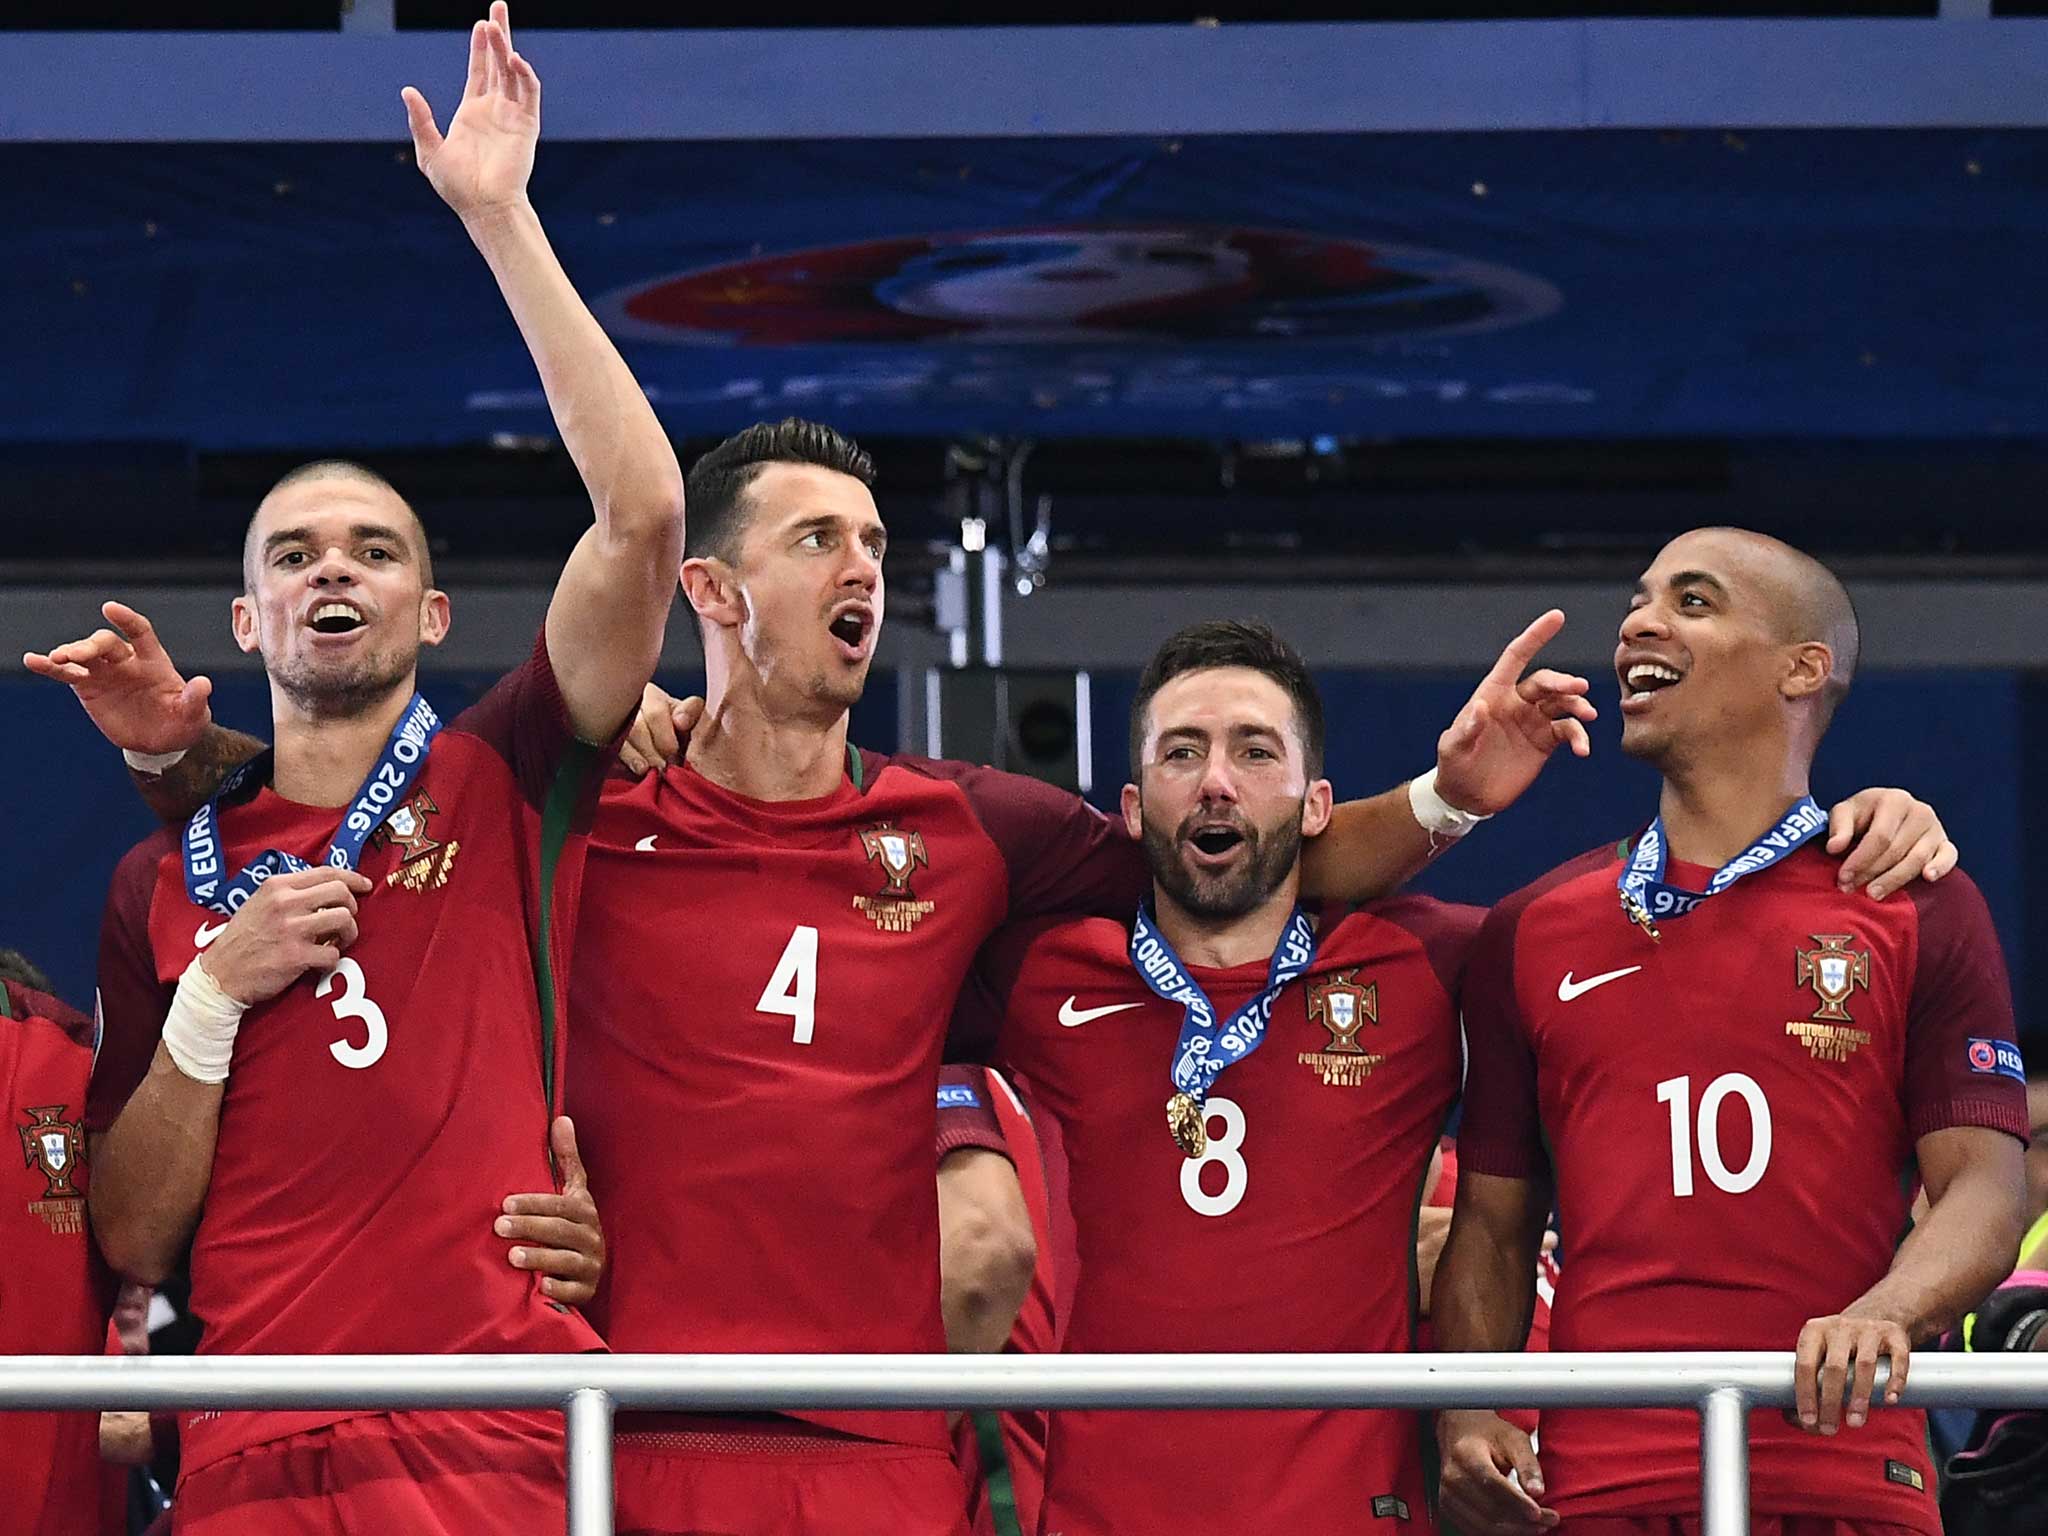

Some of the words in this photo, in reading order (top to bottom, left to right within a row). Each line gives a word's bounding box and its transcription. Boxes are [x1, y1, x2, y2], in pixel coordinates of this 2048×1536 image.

[346, 762, 406, 833] 2016
[1762, 805, 1821, 848] UEFA
[188, 803, 218, 876] EURO
[755, 924, 819, 1045] 4
[1136, 937, 1187, 992] EURO
[315, 956, 389, 1069] 3
[1997, 1049, 2024, 1072] RES
[1179, 1097, 1249, 1217] 8
[1656, 1072, 1773, 1199] 10
